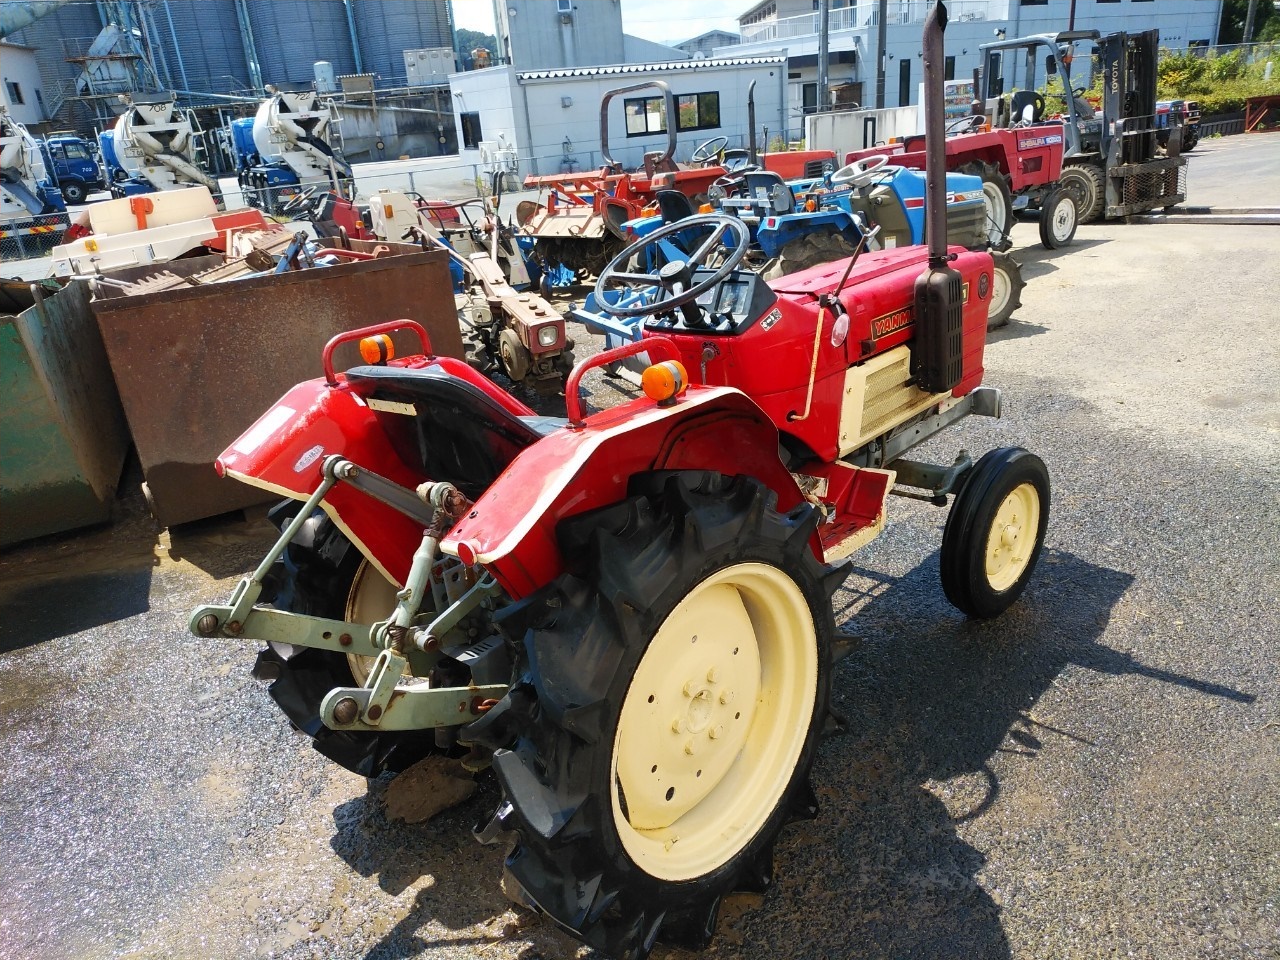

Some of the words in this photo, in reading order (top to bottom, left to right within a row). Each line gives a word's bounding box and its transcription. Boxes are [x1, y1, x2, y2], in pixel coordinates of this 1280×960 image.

[1111, 59, 1119, 95] TOYOTA
[149, 104, 167, 113] 708
[875, 309, 915, 336] YANM
